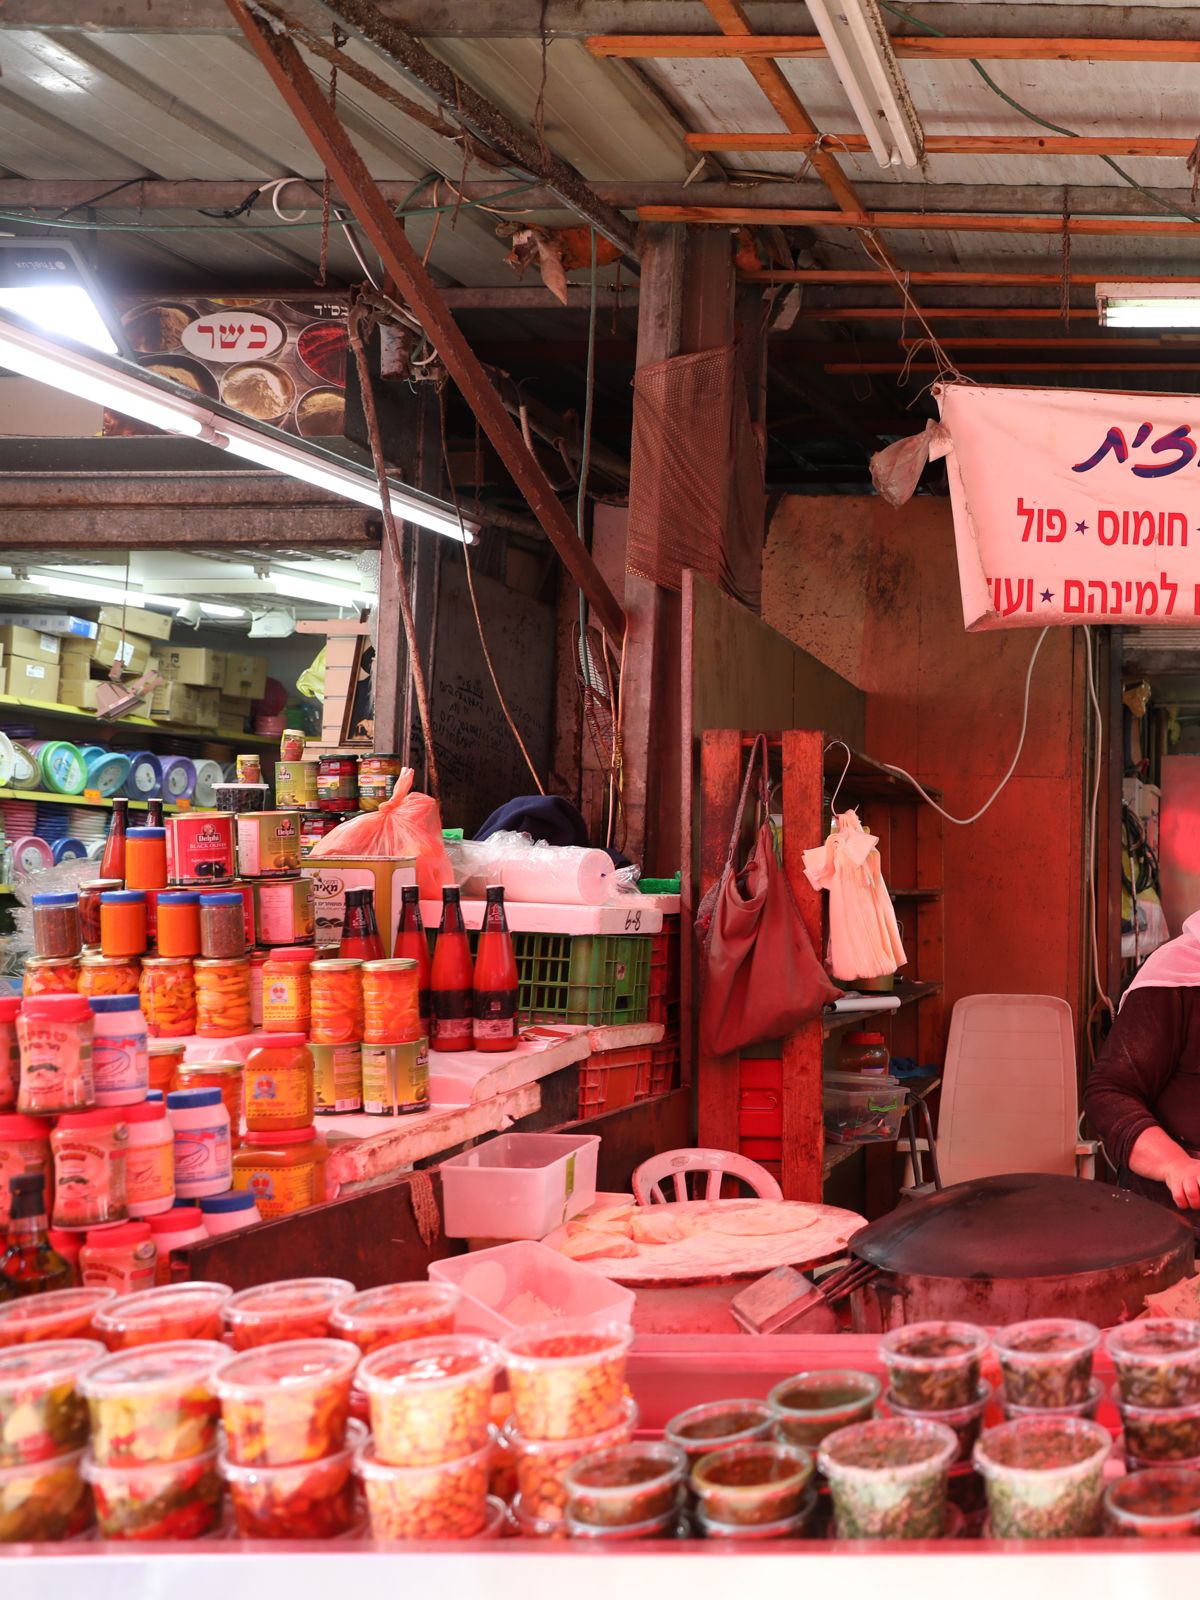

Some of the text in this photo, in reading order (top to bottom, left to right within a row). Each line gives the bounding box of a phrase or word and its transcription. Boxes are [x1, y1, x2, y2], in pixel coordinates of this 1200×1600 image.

[197, 324, 267, 349] כשר
[1017, 498, 1067, 543] פול
[1098, 510, 1188, 548] חומוס
[986, 577, 1034, 617] ועו
[1064, 572, 1178, 616] למינהם
[198, 834, 220, 843] Delphi
